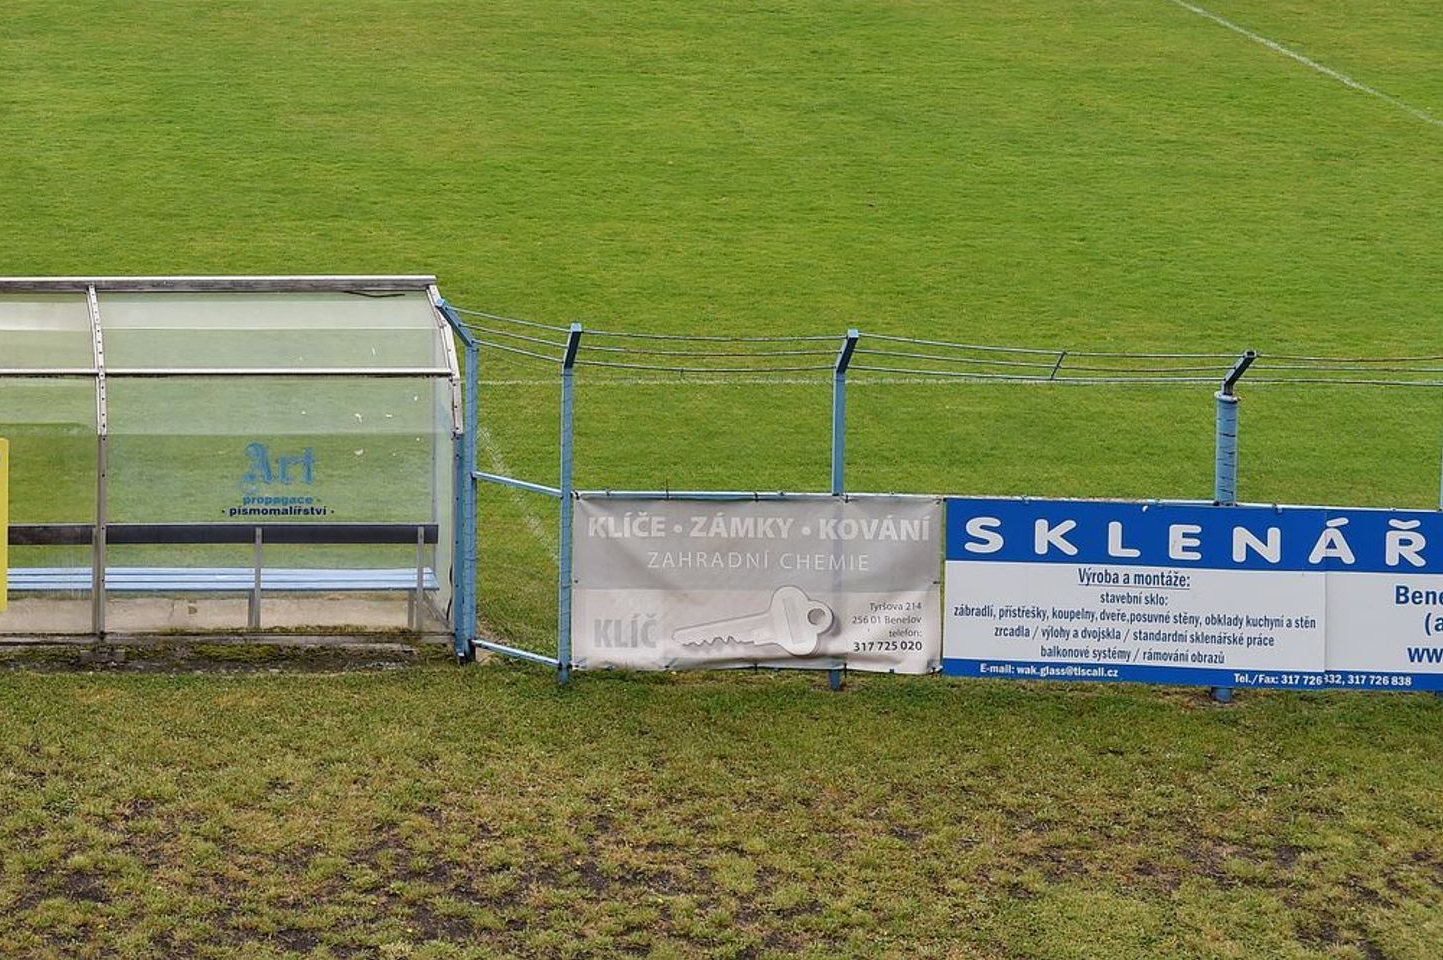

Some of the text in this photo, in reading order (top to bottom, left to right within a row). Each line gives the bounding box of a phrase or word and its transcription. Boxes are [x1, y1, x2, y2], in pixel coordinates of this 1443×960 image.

[239, 442, 315, 486] Art
[243, 496, 314, 506] propagace
[588, 512, 930, 542] KLÍČE ZÁMKY KOVÁNÍ
[964, 516, 1427, 567] SKLENÁŘ
[647, 550, 870, 572] ZAHRADNÍ CHEMIE
[1078, 568, 1190, 587] Výroba a montáže:
[870, 602, 922, 612] Tyršova 214
[1100, 592, 1168, 606] stavební sklo:
[852, 615, 922, 624] 256 01 Benešov
[954, 604, 996, 620] zábradlí,
[998, 606, 1049, 622] přístřešky,
[1052, 608, 1098, 622] koupelny,
[1173, 613, 1202, 628] stěny,
[1204, 614, 1243, 629] obklady
[1246, 616, 1284, 630] kuchyní
[1286, 619, 1292, 628] a
[1294, 616, 1316, 628] stěn
[854, 641, 922, 652] 317 725 020
[994, 626, 1030, 638] zrcadla
[1041, 626, 1070, 640] výlohy
[1072, 630, 1078, 638] a
[1081, 626, 1121, 642] dvojskla
[1133, 630, 1188, 643] standardní
[1190, 631, 1244, 646] sklenářské
[1246, 634, 1275, 648] práce
[1040, 645, 1090, 658] balkonové
[1092, 646, 1131, 662] systémy
[1143, 648, 1189, 662] rámování
[1190, 650, 1225, 664] obrazů
[980, 663, 1118, 678] E-mail: wak.glass@tiscali.cz
[1234, 673, 1278, 685] Tel./Fax:
[1281, 675, 1300, 684] 317
[1302, 675, 1324, 685] 726
[1348, 675, 1368, 685] 317
[1370, 676, 1389, 685] 726
[1391, 676, 1412, 686] 838
